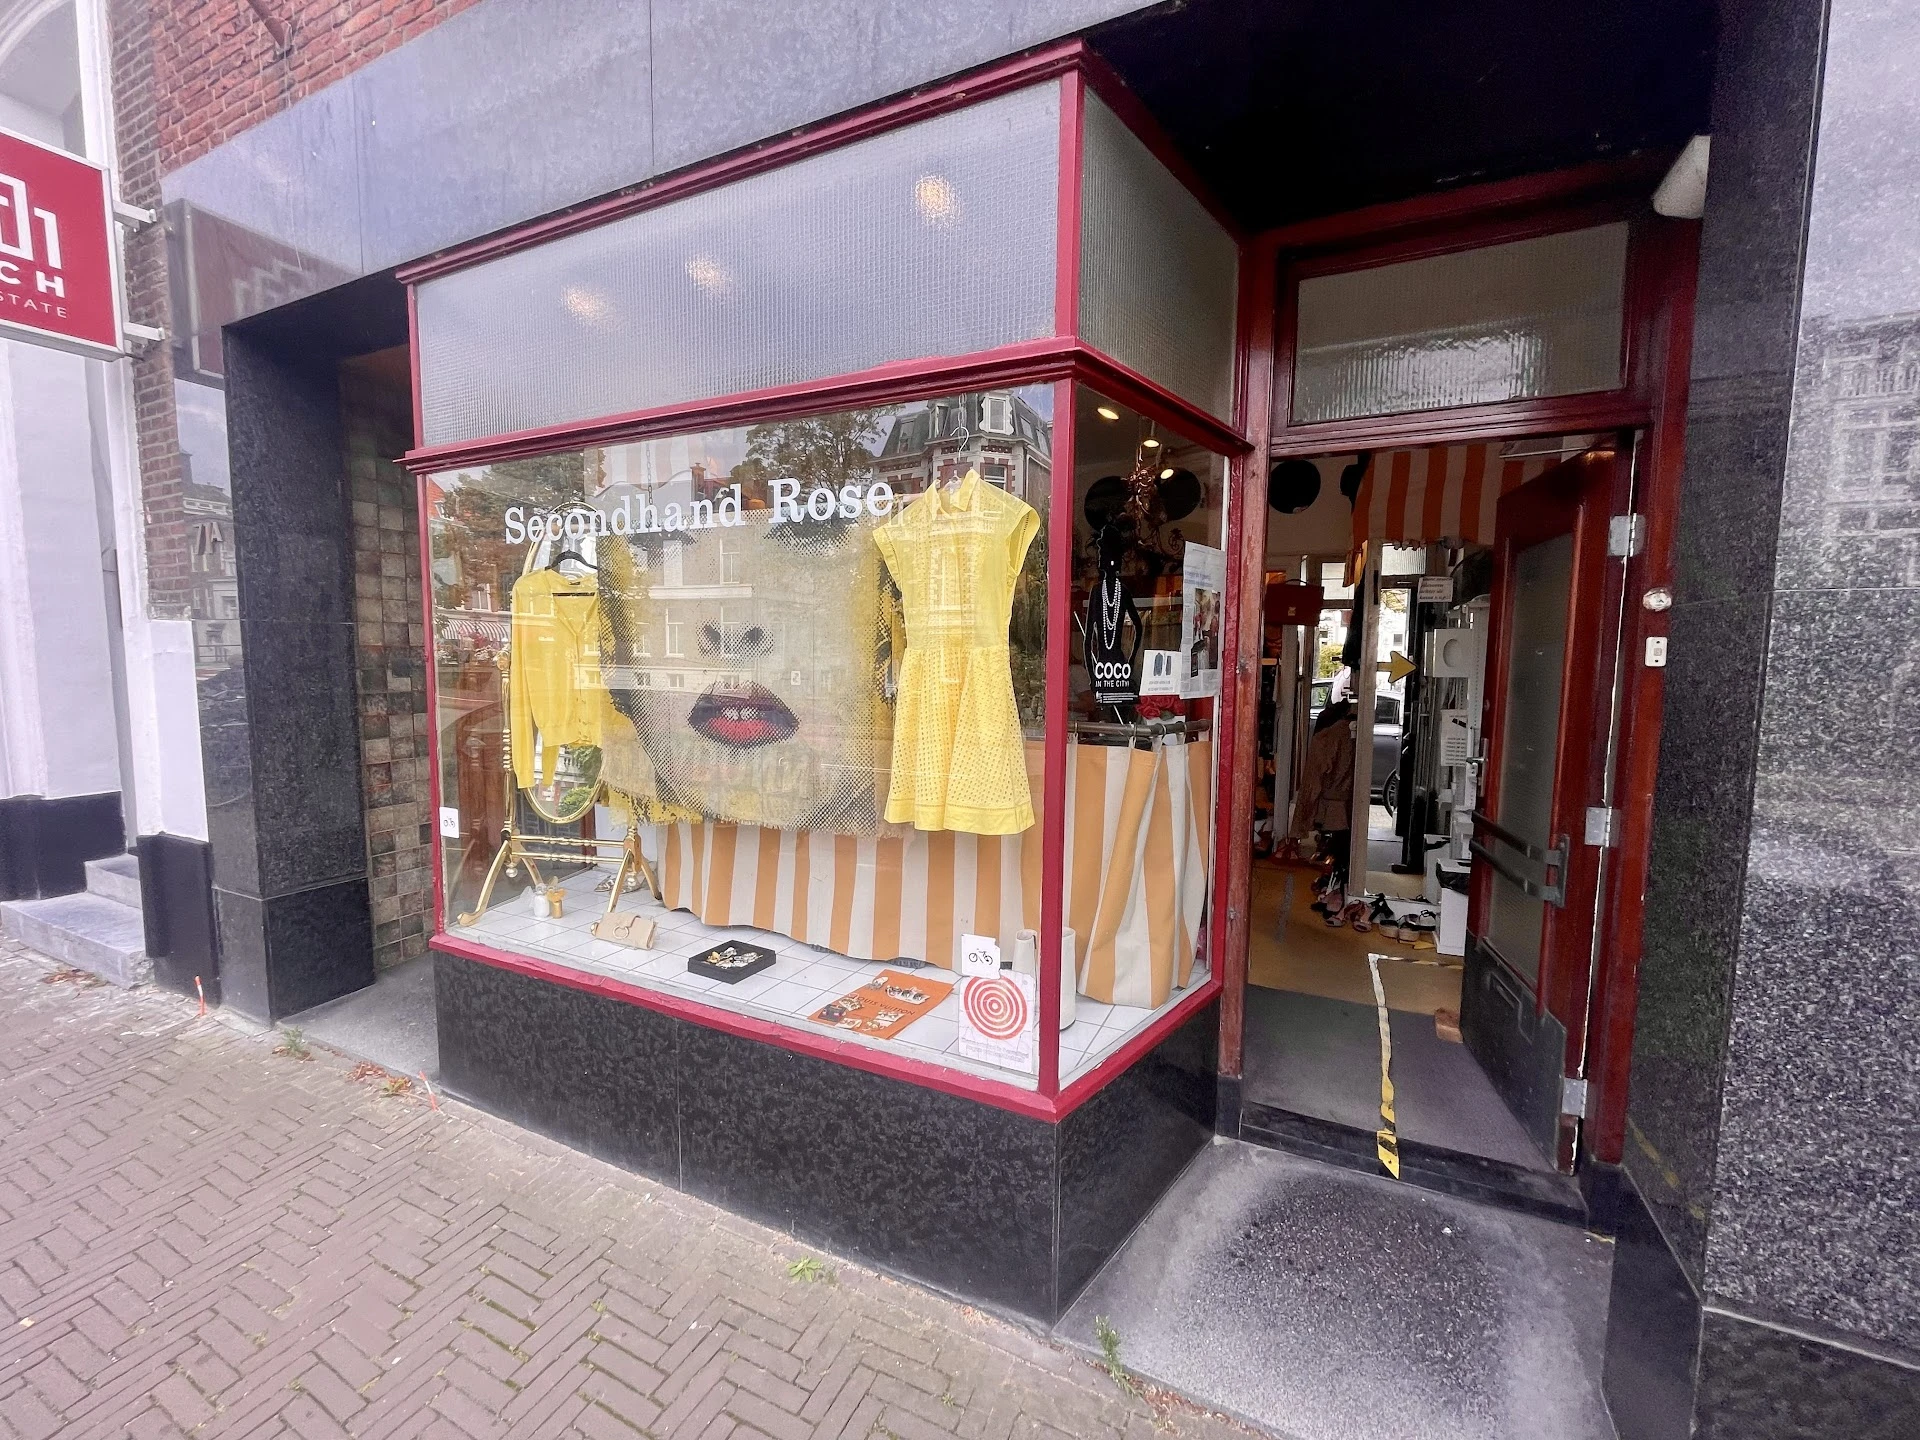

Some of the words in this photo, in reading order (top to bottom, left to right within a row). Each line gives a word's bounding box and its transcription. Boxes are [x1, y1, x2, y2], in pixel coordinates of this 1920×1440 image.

[505, 483, 746, 545] Secondhand
[768, 477, 895, 524] Rose
[1095, 662, 1131, 679] COCO
